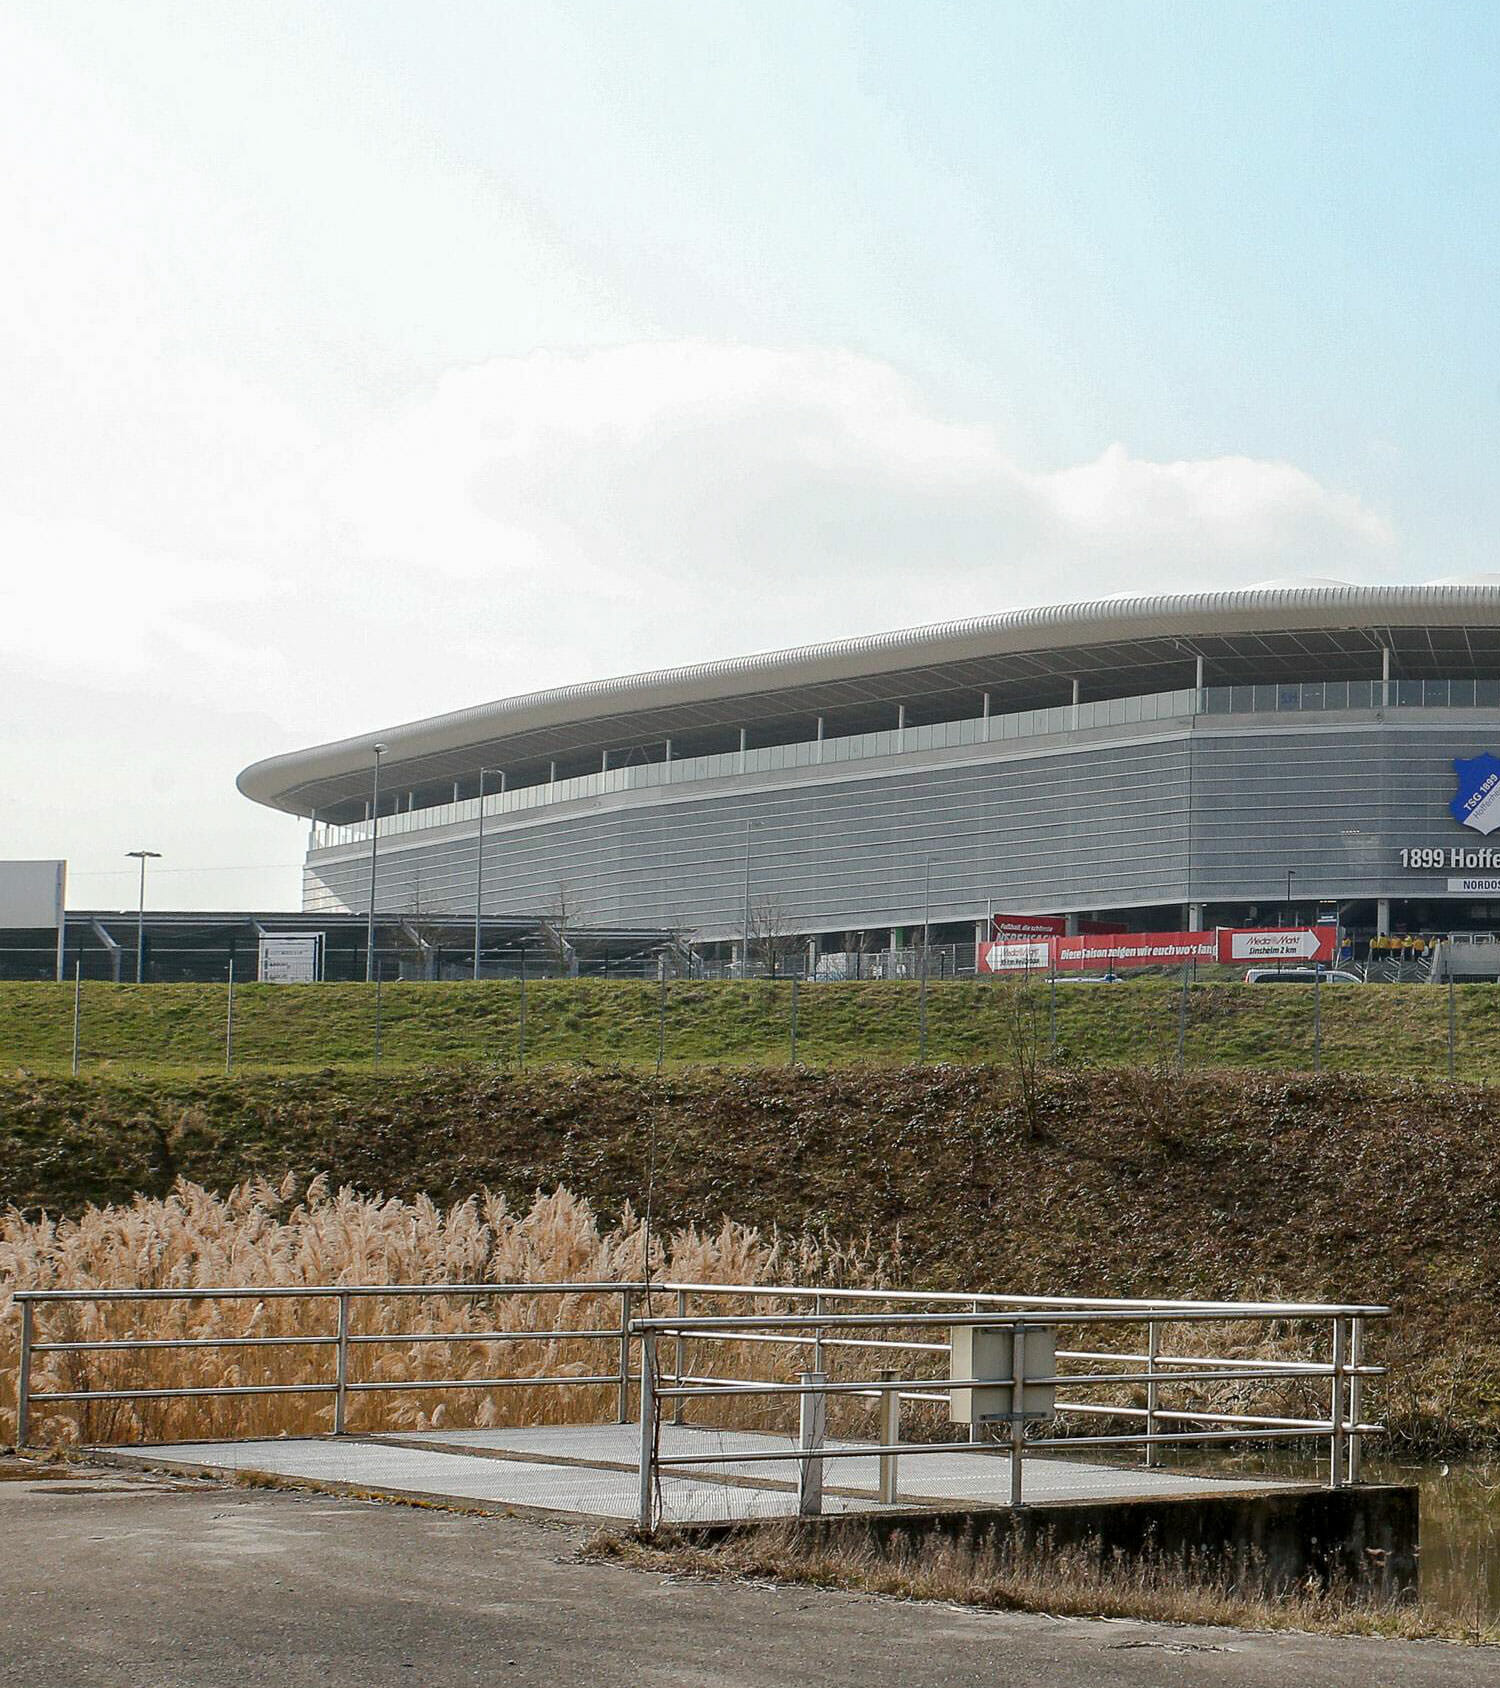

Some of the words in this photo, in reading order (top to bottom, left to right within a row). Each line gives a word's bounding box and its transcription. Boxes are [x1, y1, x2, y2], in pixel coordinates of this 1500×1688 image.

[1463, 792, 1482, 811] TSG
[1479, 773, 1499, 795] 1899
[1400, 848, 1445, 869] 1899
[1061, 950, 1080, 960] Diese
[1108, 947, 1136, 958] zeigen
[1136, 947, 1153, 957] wir
[1153, 945, 1175, 956] euch
[1249, 947, 1279, 955] Sinsheim
[1286, 946, 1297, 954] km
